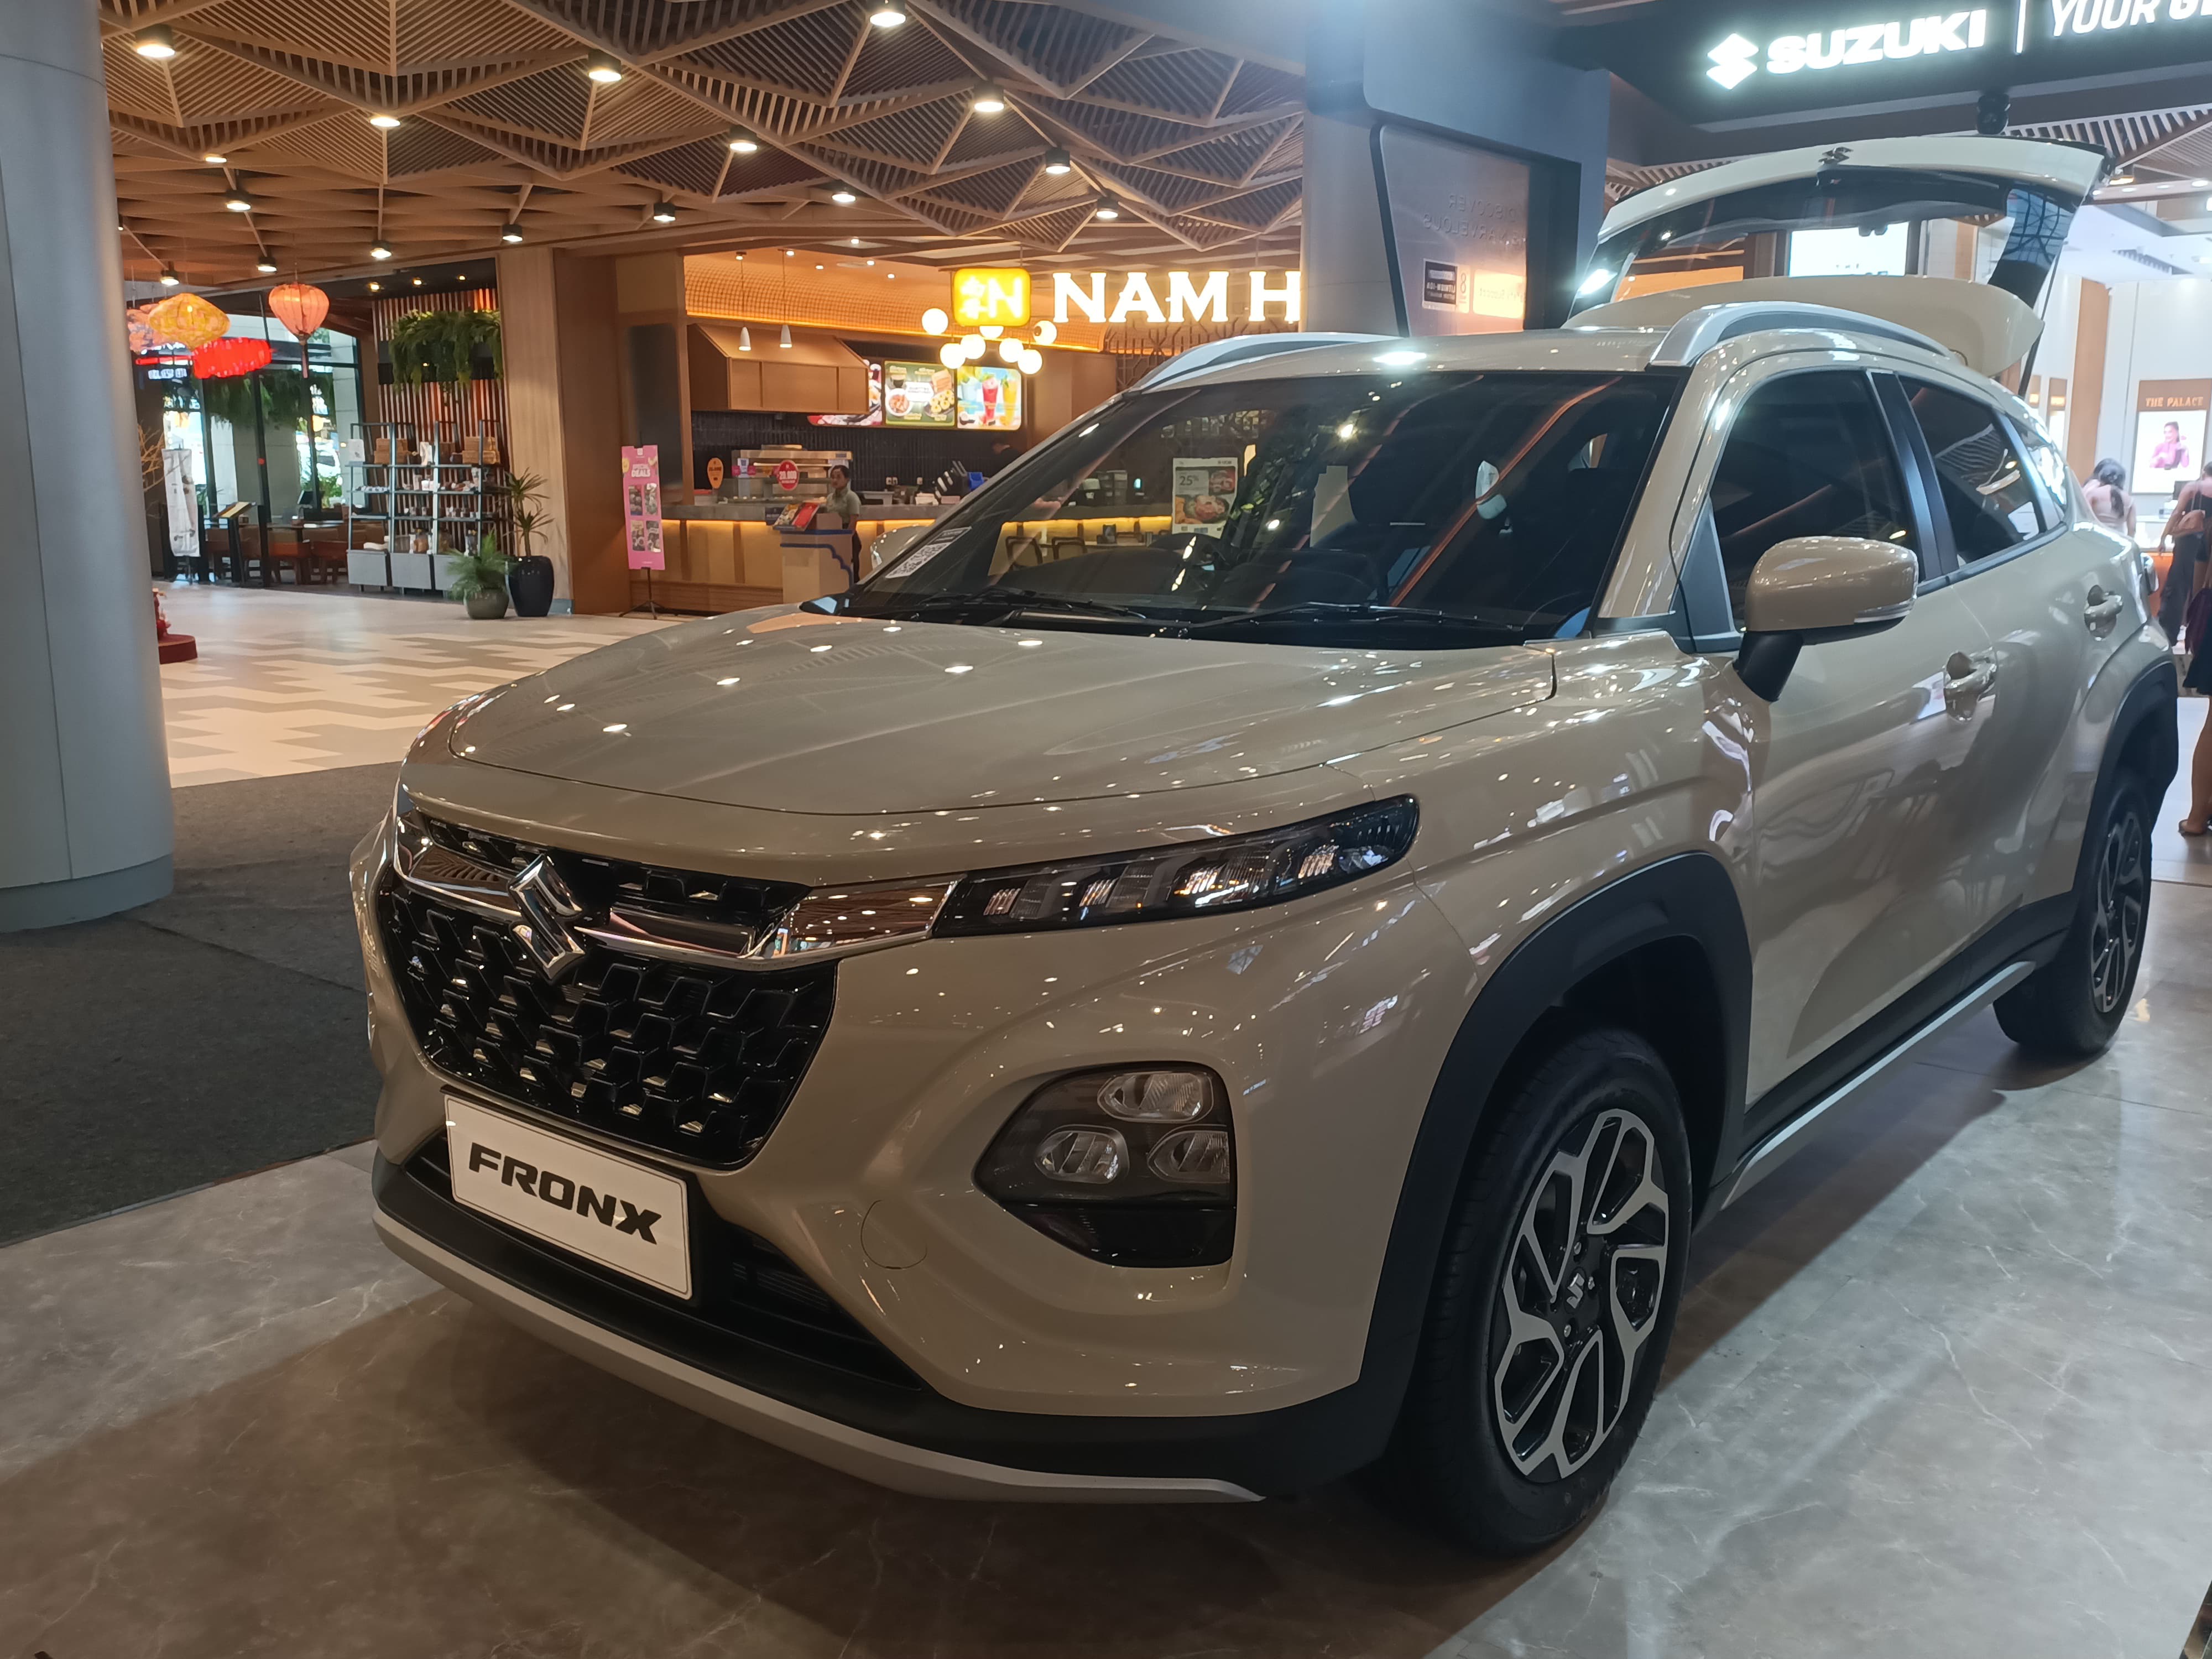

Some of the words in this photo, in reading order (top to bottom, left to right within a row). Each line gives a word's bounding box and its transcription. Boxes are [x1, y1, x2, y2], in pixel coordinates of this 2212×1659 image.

[1766, 9, 1987, 74] SUZUKI
[2051, 0, 2161, 36] YOUR
[1052, 270, 1229, 323] NAM
[2145, 397, 2163, 408] THE
[2167, 396, 2204, 407] PALACE
[468, 1141, 662, 1245] FRONX
